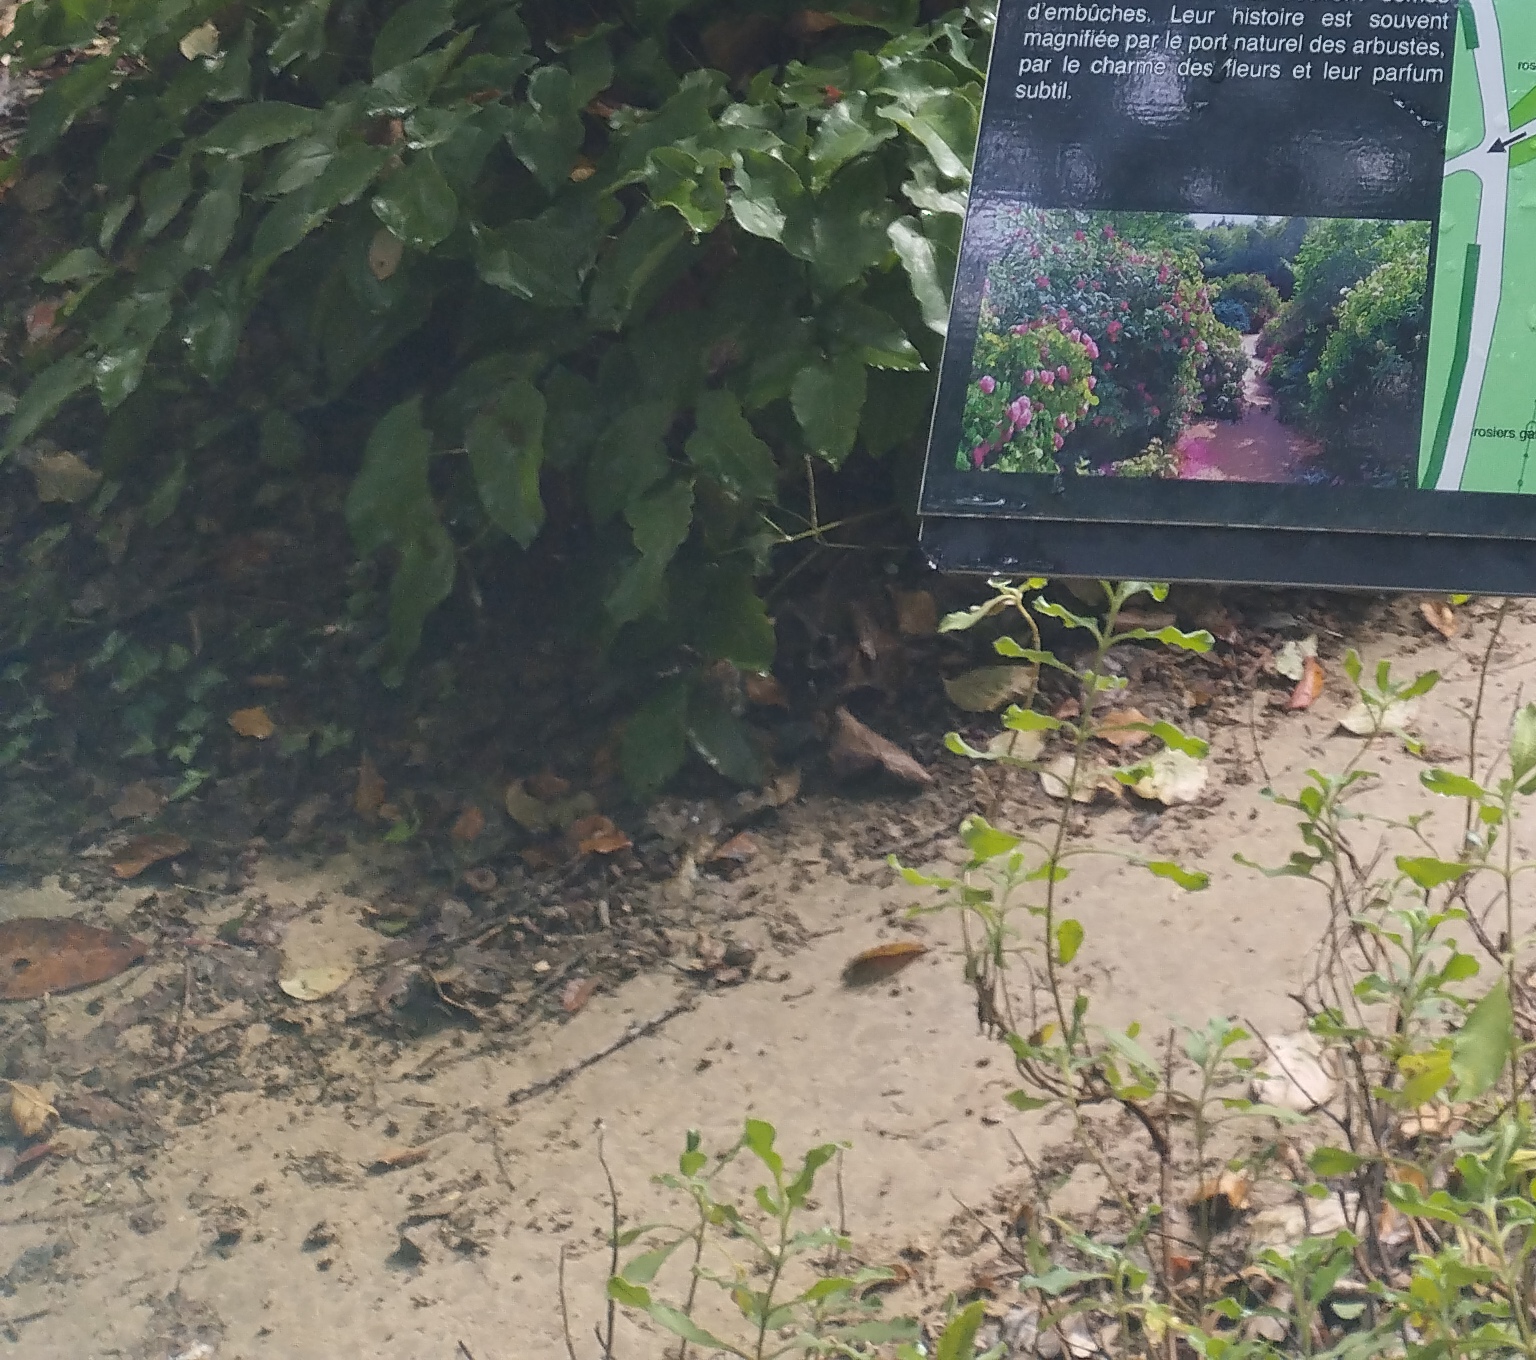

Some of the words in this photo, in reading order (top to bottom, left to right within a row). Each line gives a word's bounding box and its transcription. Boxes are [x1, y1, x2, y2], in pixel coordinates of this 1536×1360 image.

[1028, 3, 1151, 23] d'embûches.
[1171, 6, 1215, 23] Leur
[1232, 8, 1304, 26] histoire
[1321, 11, 1352, 27] est
[1369, 13, 1449, 30] souvent
[1024, 30, 1119, 51] magnifiée
[1125, 33, 1159, 52] par
[1166, 31, 1182, 49] le
[1189, 34, 1228, 53] port
[1234, 35, 1303, 53] naturel
[1310, 35, 1346, 54] des
[1353, 39, 1444, 58] arbustes,
[1019, 57, 1051, 75] par
[1063, 56, 1080, 73] le
[1091, 56, 1166, 75] charme
[1178, 58, 1214, 76] des
[1226, 59, 1280, 78] fleurs
[1293, 62, 1312, 79] et
[1324, 62, 1362, 79] leur
[1373, 64, 1444, 84] parfum
[1015, 82, 1072, 100] subtil.
[1473, 427, 1515, 438] rosiers
